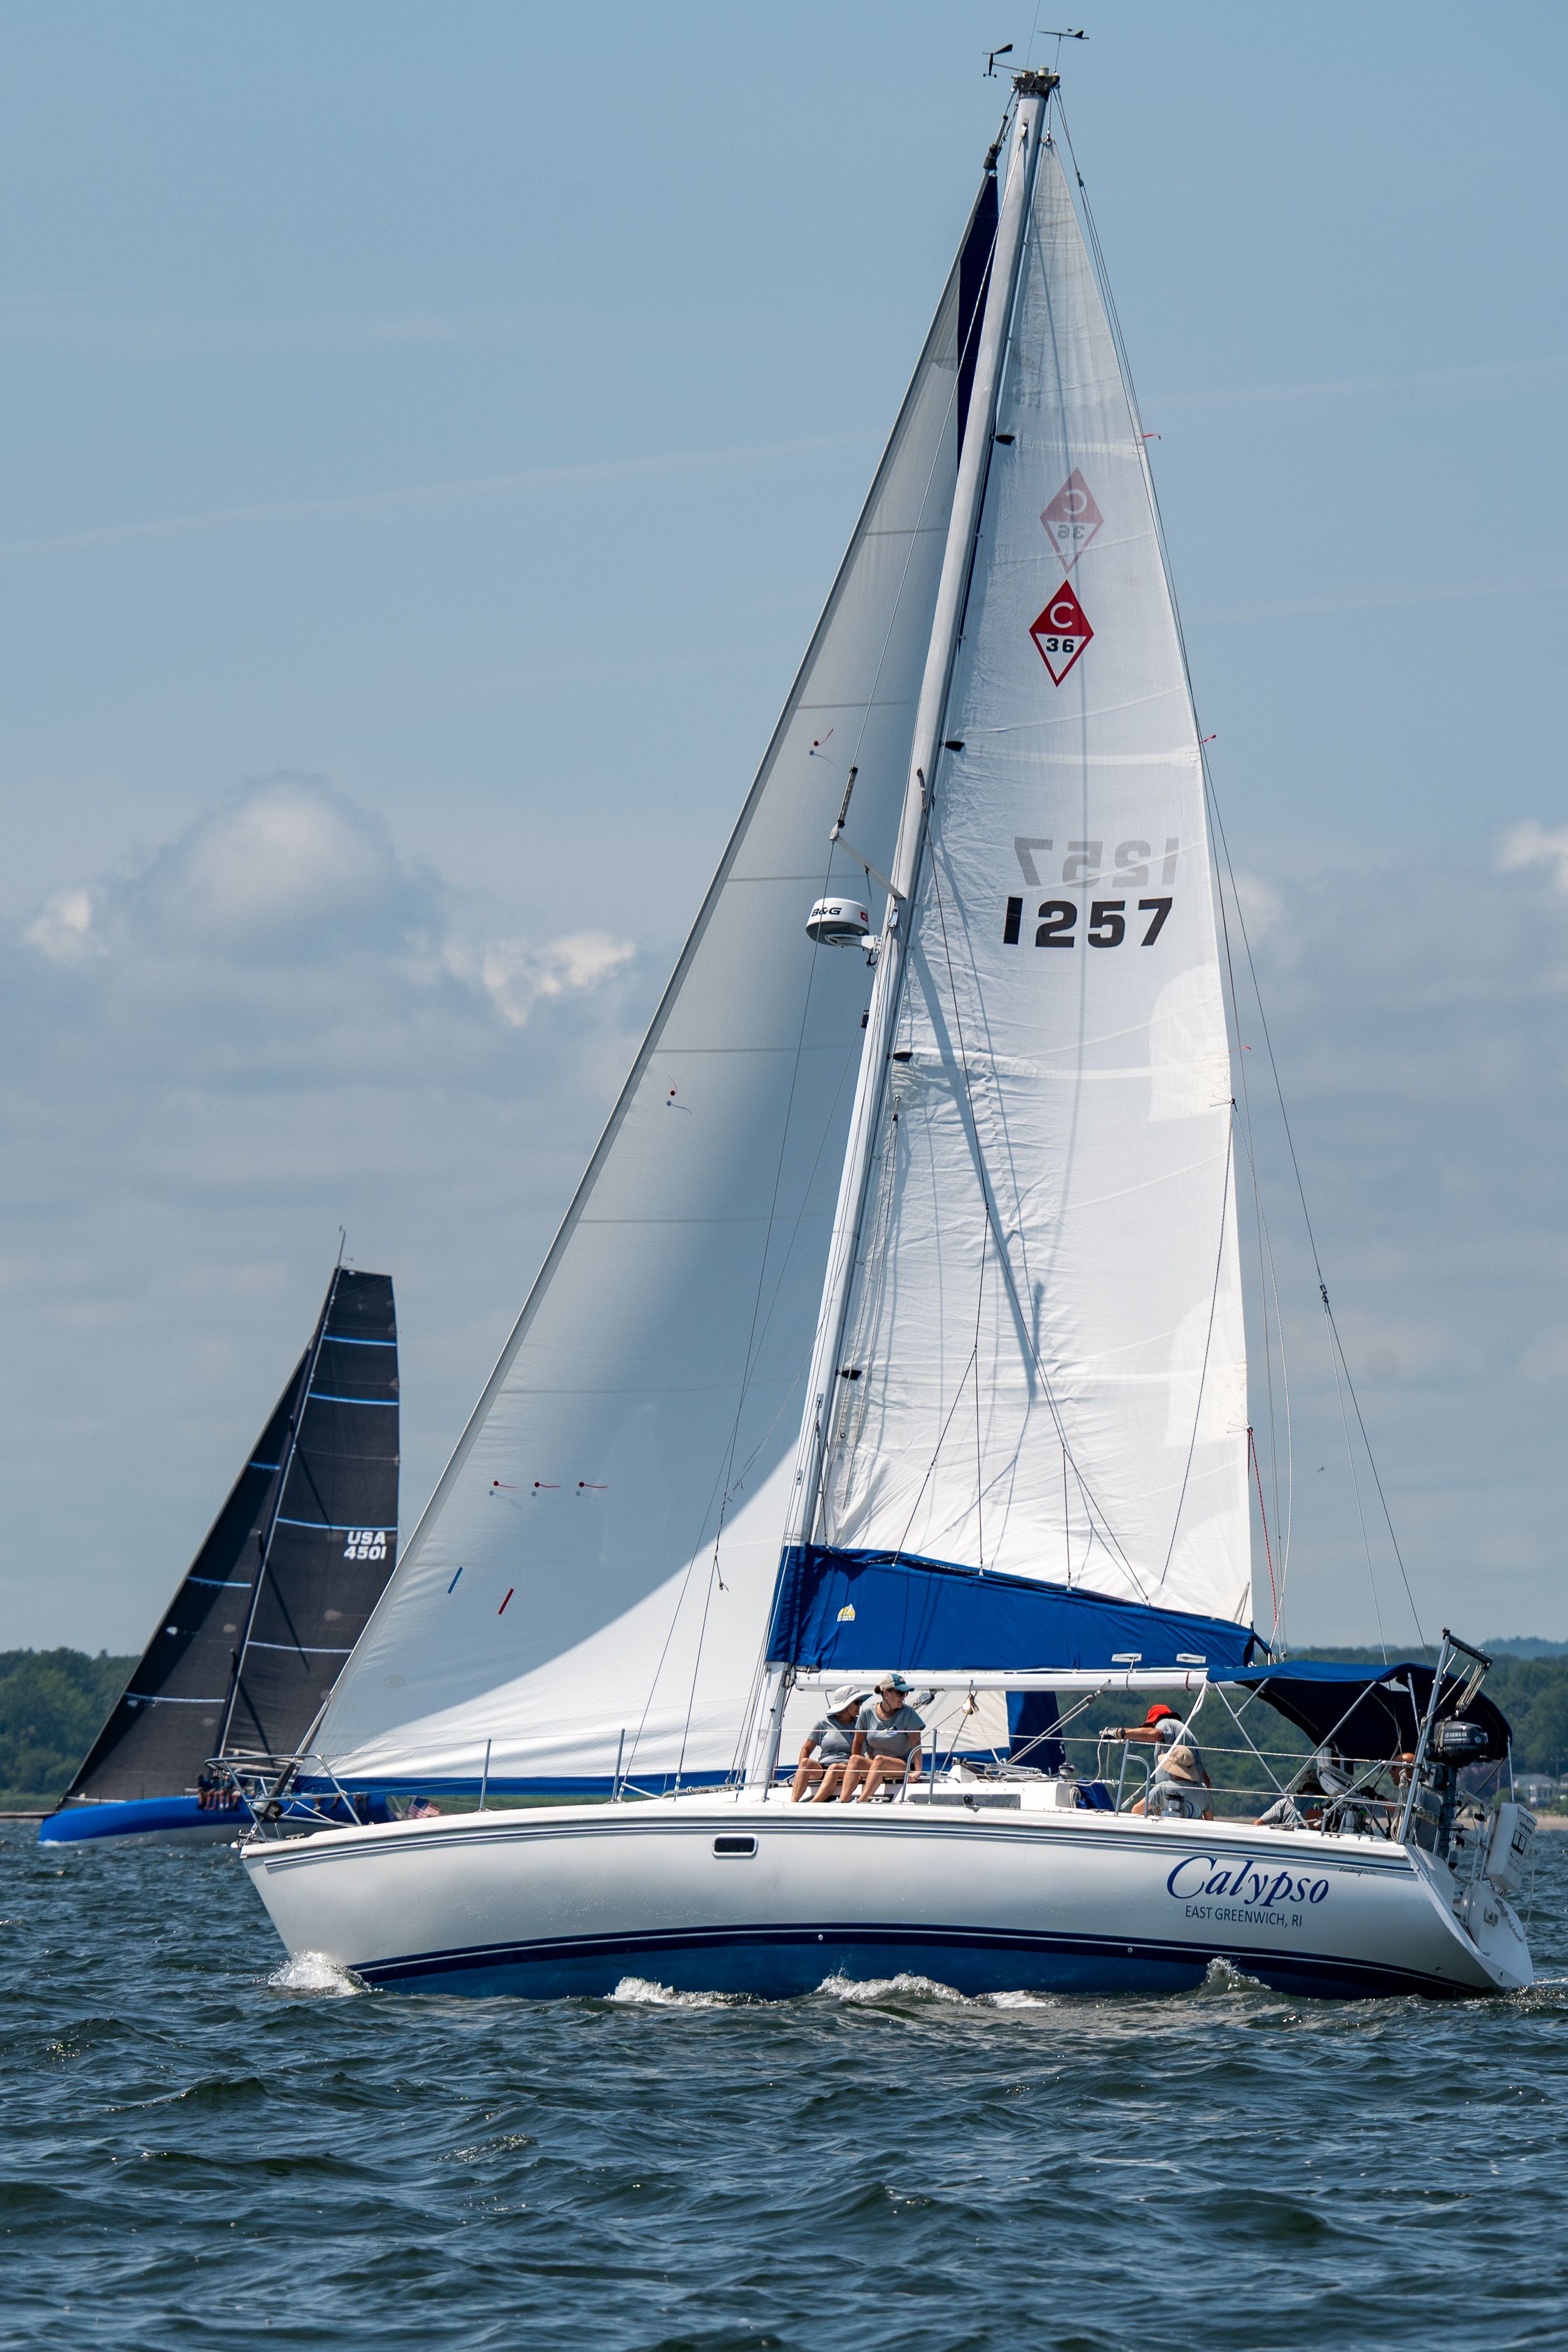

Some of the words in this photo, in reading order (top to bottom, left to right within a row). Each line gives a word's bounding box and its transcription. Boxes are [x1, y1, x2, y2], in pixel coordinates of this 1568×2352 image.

[1050, 601, 1074, 628] C
[1046, 638, 1074, 653] 36
[811, 907, 842, 917] B&G
[1003, 896, 1173, 949] 1257
[347, 1531, 386, 1545] USA
[344, 1546, 387, 1560] 4501
[1167, 1855, 1329, 1908] Calypso
[1185, 1905, 1213, 1919] EAST
[1214, 1908, 1287, 1929] GREENWICH,
[1292, 1915, 1303, 1927] RI
